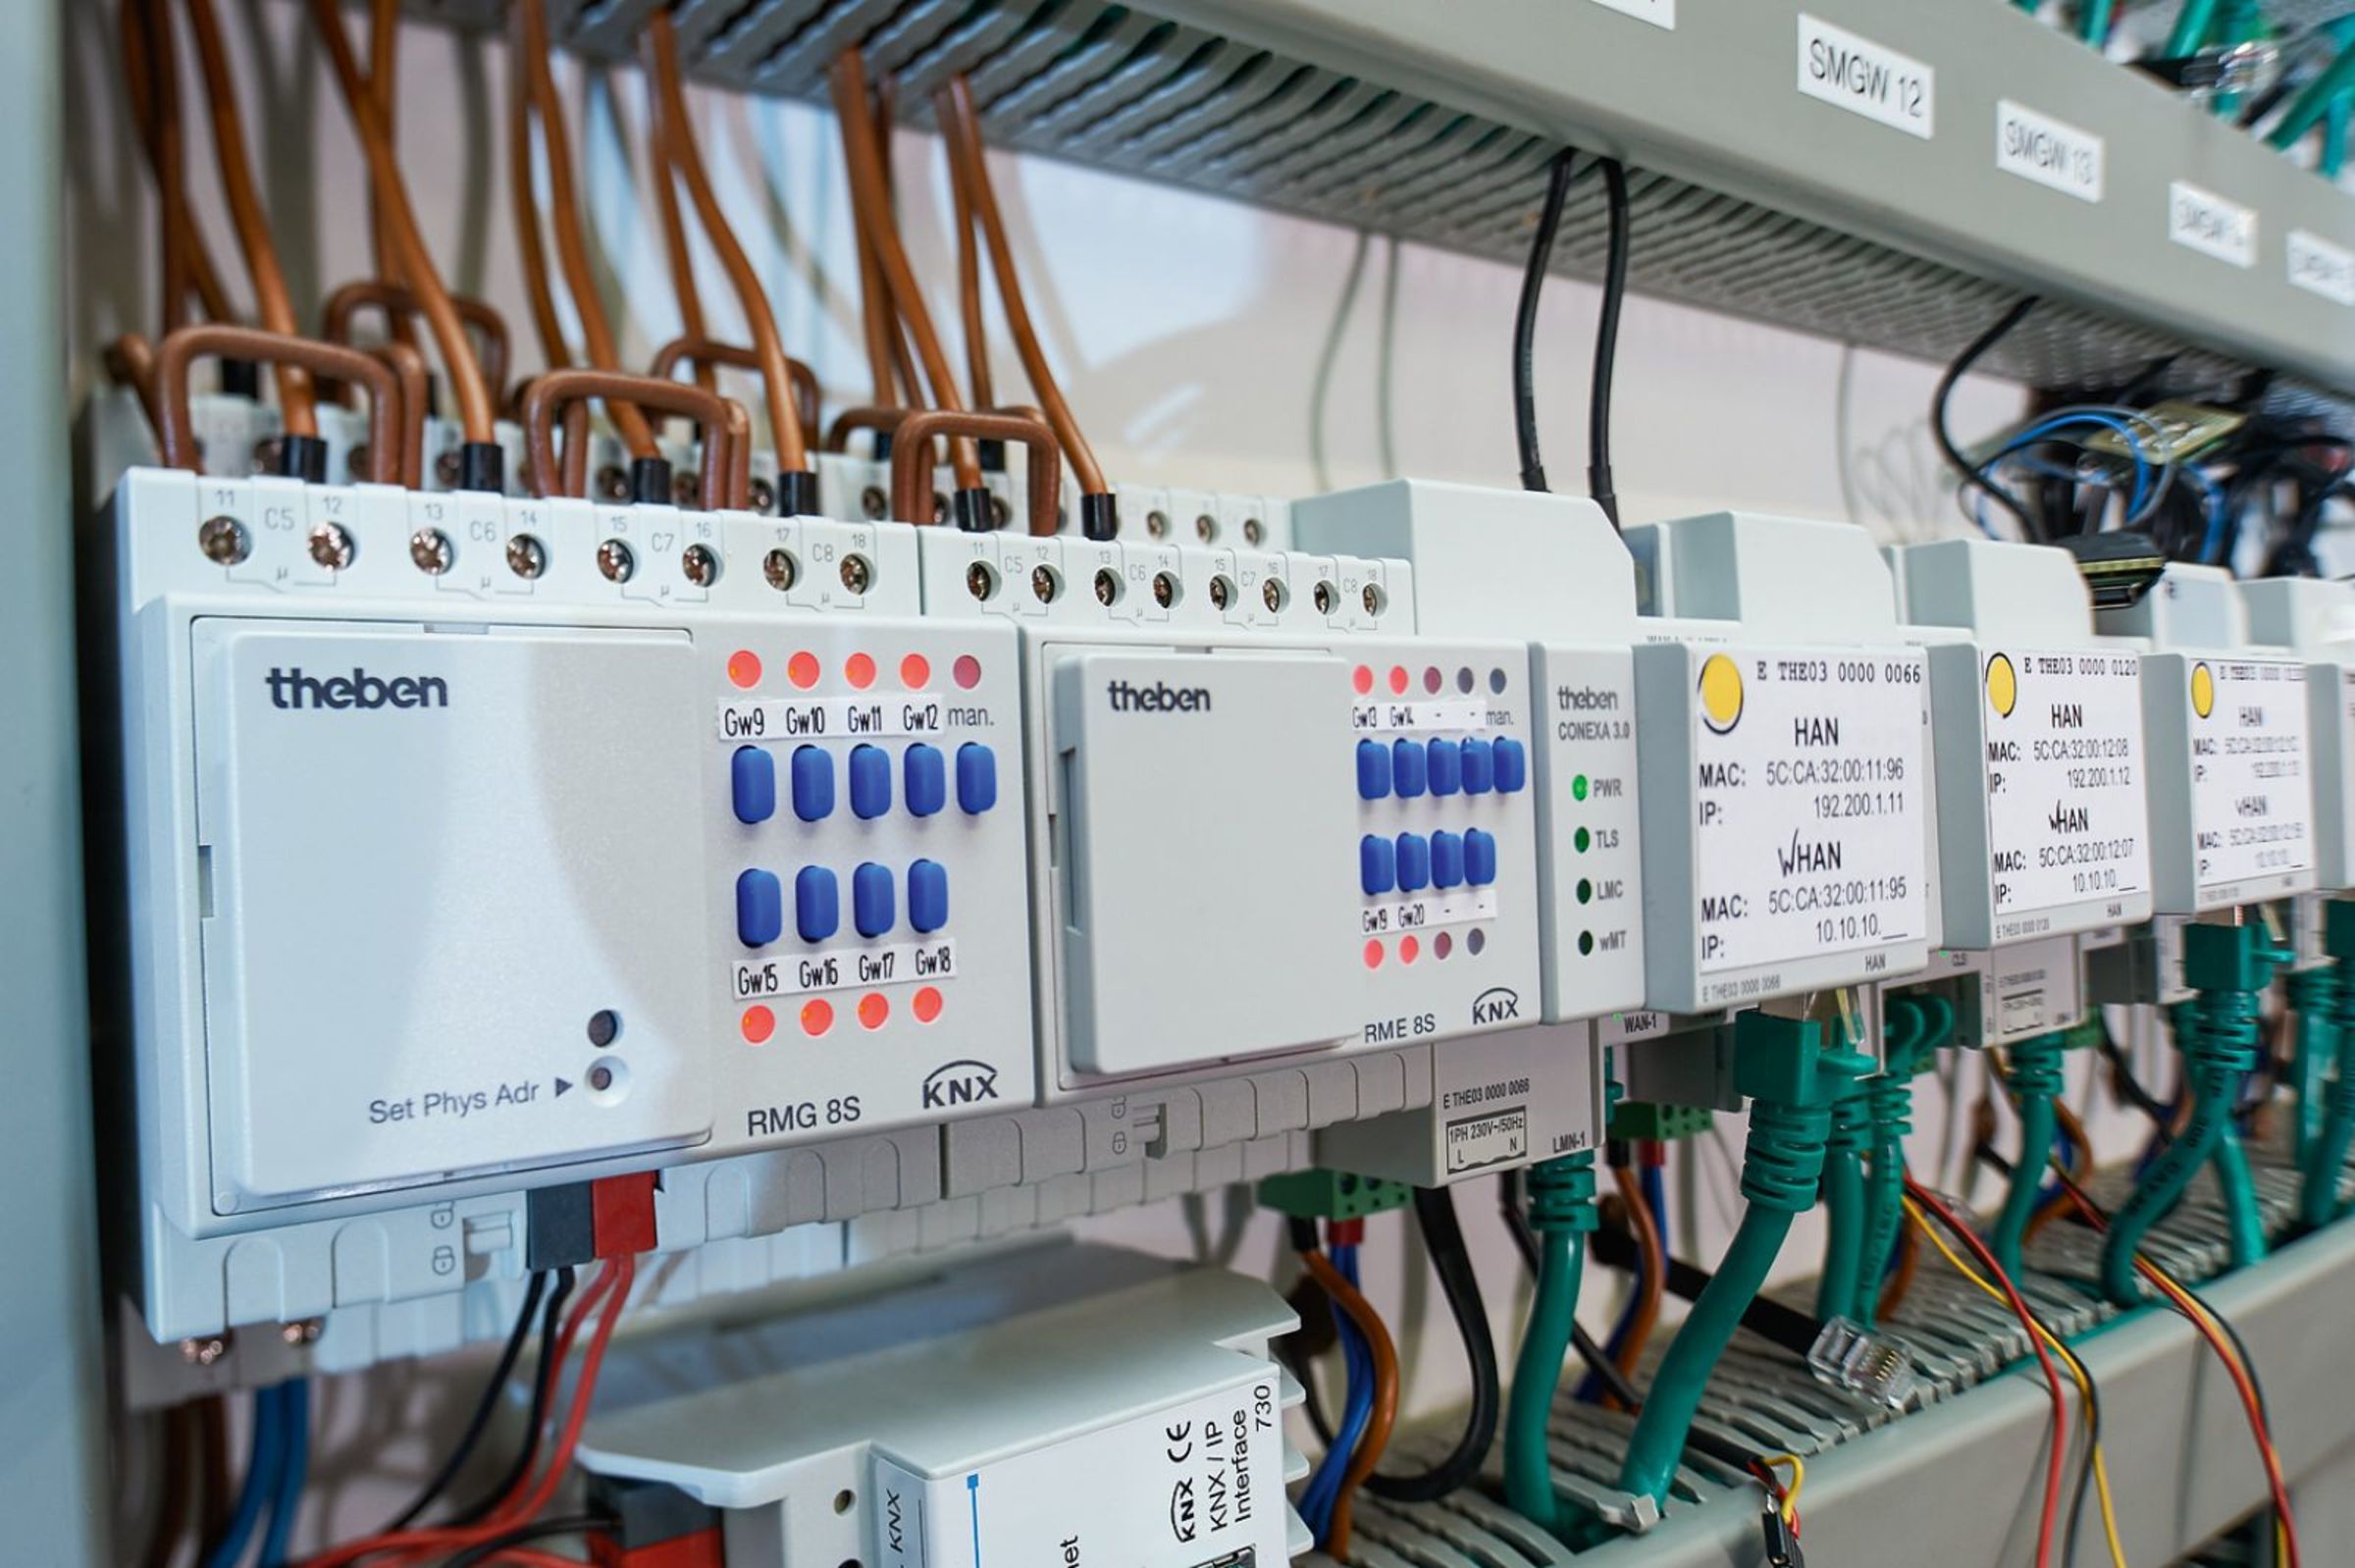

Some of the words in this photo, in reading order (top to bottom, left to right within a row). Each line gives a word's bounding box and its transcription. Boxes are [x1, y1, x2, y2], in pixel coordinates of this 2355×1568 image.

[1809, 38, 1889, 103] SMGW
[1899, 77, 1922, 118] 12
[2005, 121, 2066, 171] SMGW
[215, 491, 236, 505] 11
[323, 497, 342, 514] 12
[265, 507, 294, 530] C5
[425, 503, 444, 520] 13
[520, 509, 538, 526] 14
[470, 520, 497, 541] C6
[611, 516, 627, 532] 15
[697, 522, 710, 537] 16
[777, 528, 790, 542] 17
[652, 533, 674, 552] C7
[853, 534, 865, 548] 18
[812, 544, 834, 561] C8
[1005, 555, 1023, 573] C5
[1129, 564, 1146, 580] C6
[1757, 661, 1767, 681] E
[1778, 661, 1828, 682] THE03
[1838, 662, 1875, 683] 0000
[1885, 664, 1920, 684] 0066
[265, 667, 448, 708] theben
[1107, 680, 1211, 711] theben
[1558, 686, 1617, 710] theben
[725, 707, 764, 737] Gw9
[786, 706, 825, 735] Gw10
[848, 706, 882, 732] Gw11
[904, 704, 938, 731] Gw12
[948, 706, 994, 726] man.
[1486, 710, 1513, 726] man.
[2051, 704, 2082, 728] HAN
[1558, 721, 1610, 741] CONEXA
[1613, 721, 1630, 740] 3.0
[1795, 717, 1839, 747] HAN
[1988, 742, 2021, 762] MAC:
[1700, 762, 1747, 788] MAC:
[1990, 773, 2006, 794] IP:
[1594, 779, 1622, 797] PWR
[1700, 802, 1723, 825] IP:
[1813, 792, 1904, 819] 192.200.1.11
[1596, 830, 1618, 848] TLS
[1994, 851, 2026, 872] MAC:
[1597, 881, 1623, 900] LMC
[1996, 884, 2012, 904] IP:
[1398, 904, 1424, 927] Gw20
[1701, 895, 1749, 921] MAC:
[1599, 930, 1627, 952] wMT
[1701, 935, 1725, 960] IP:
[739, 964, 778, 995] Gw15
[800, 959, 838, 987] Gw16
[860, 953, 894, 981] Gw17
[916, 947, 951, 975] Gw18
[1865, 954, 1886, 972] HAN
[1472, 1000, 1518, 1024] KNX
[1365, 1018, 1407, 1043] RME
[1414, 1013, 1436, 1034] 8S
[1624, 1014, 1656, 1033] WAN-1
[369, 1099, 414, 1124] Set
[424, 1091, 488, 1118] Phys
[496, 1081, 540, 1105] Adr
[923, 1074, 999, 1110] KNX
[1443, 1093, 1450, 1109] E
[1452, 1086, 1483, 1107] THE03
[1486, 1082, 1506, 1100] 0000
[748, 1103, 817, 1136] RMG
[826, 1096, 861, 1124] 8S
[1450, 1125, 1468, 1143] 1PH
[1509, 1136, 1517, 1151] N
[1553, 1131, 1586, 1153] LMN-1
[1254, 1385, 1273, 1432] 730
[1205, 1421, 1224, 1447] IP
[1231, 1409, 1251, 1523] Interface
[1178, 1477, 1195, 1542] KNX
[1208, 1469, 1228, 1532] KNX
[886, 1489, 903, 1553] KNX
